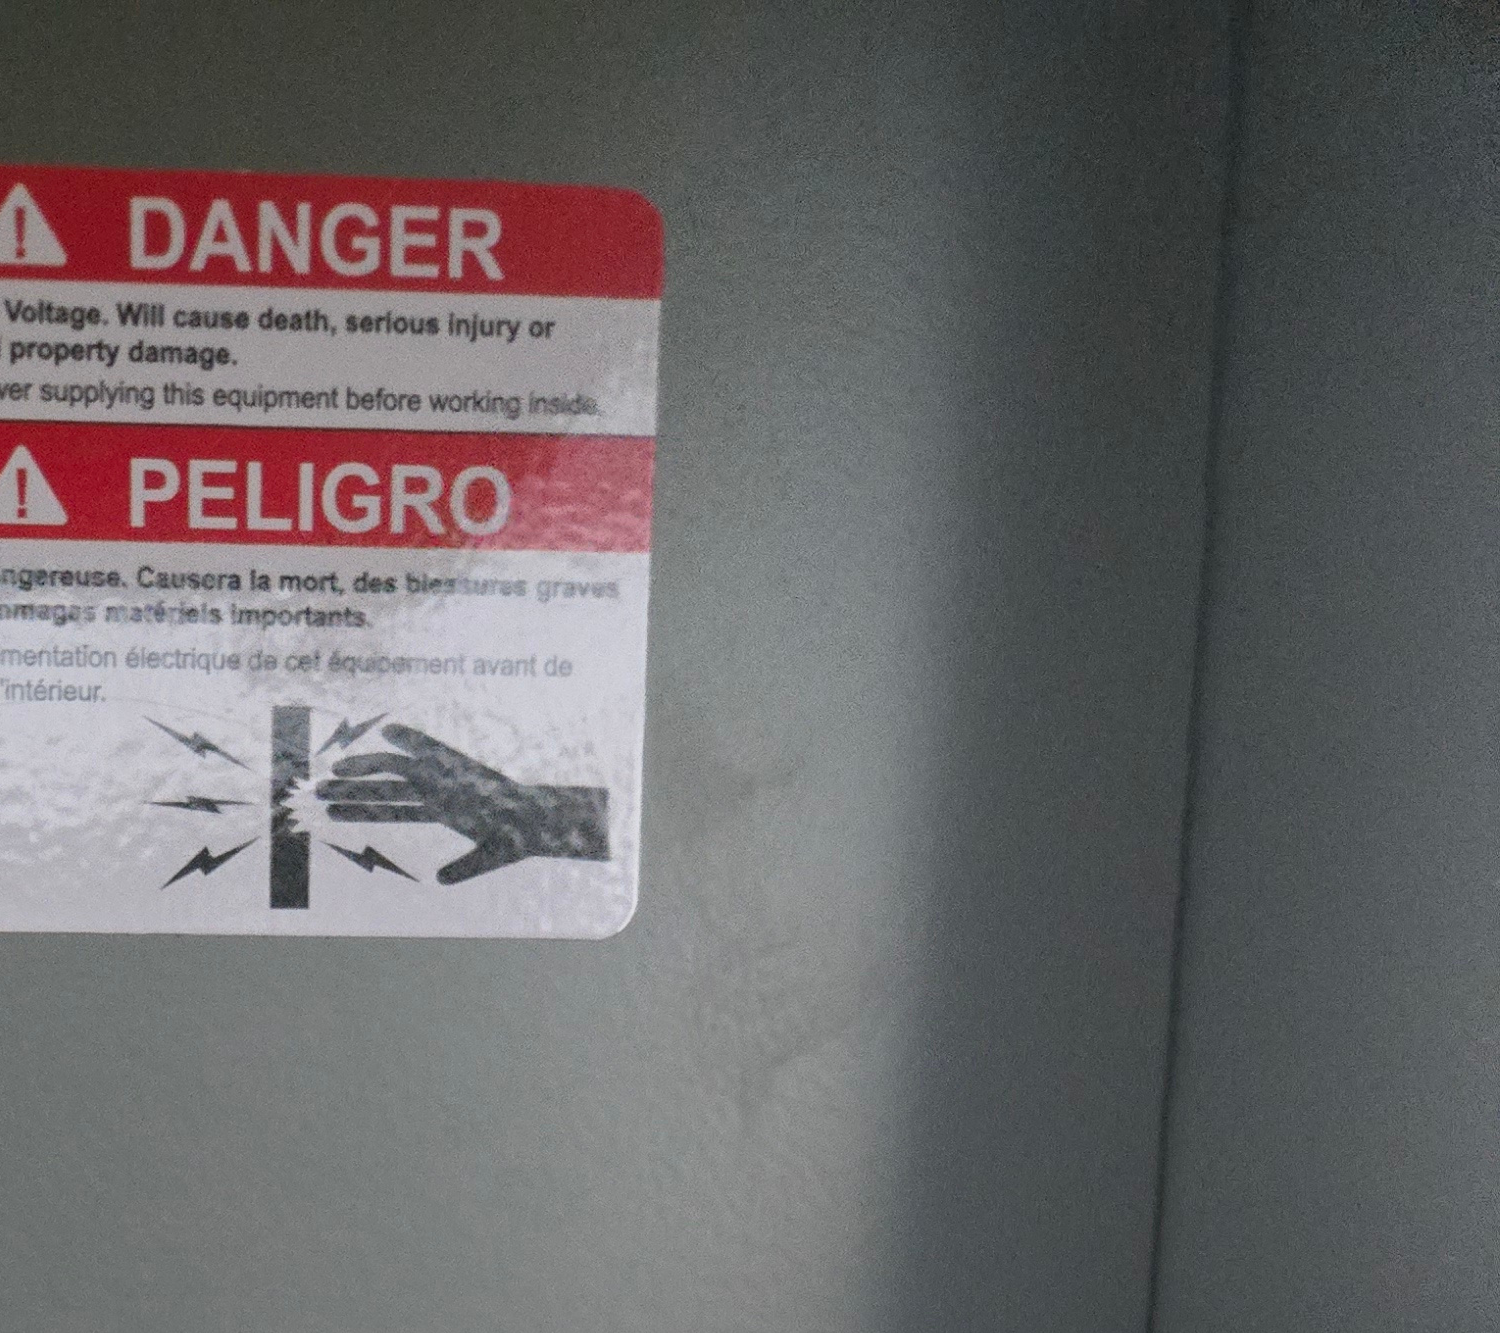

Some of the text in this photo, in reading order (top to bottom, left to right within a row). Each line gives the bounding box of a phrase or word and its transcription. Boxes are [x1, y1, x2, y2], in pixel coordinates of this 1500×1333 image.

[129, 196, 506, 281] DANGER
[4, 299, 108, 330] Voltage.
[116, 302, 165, 327] Will
[173, 307, 250, 330] cause
[258, 307, 337, 336] death,
[346, 310, 439, 336] serious
[449, 311, 519, 343] injury
[528, 319, 556, 339] or
[9, 339, 119, 367] property
[128, 340, 238, 370] damage.
[40, 378, 155, 410] supplying
[163, 380, 205, 406] this
[212, 383, 338, 412] equipment
[346, 387, 421, 413] before
[429, 390, 521, 420] working
[129, 458, 511, 537] PELIGRO
[250, 569, 269, 591] la
[279, 572, 344, 595] mort,
[353, 572, 397, 594] des
[536, 579, 620, 604] graves
[105, 599, 222, 625] matériels
[231, 604, 371, 631] importants.
[124, 644, 242, 675] électrique
[248, 650, 278, 672] de
[285, 651, 320, 673] cet
[328, 652, 465, 680] équipement
[473, 656, 538, 678] avant
[544, 655, 574, 678] de
